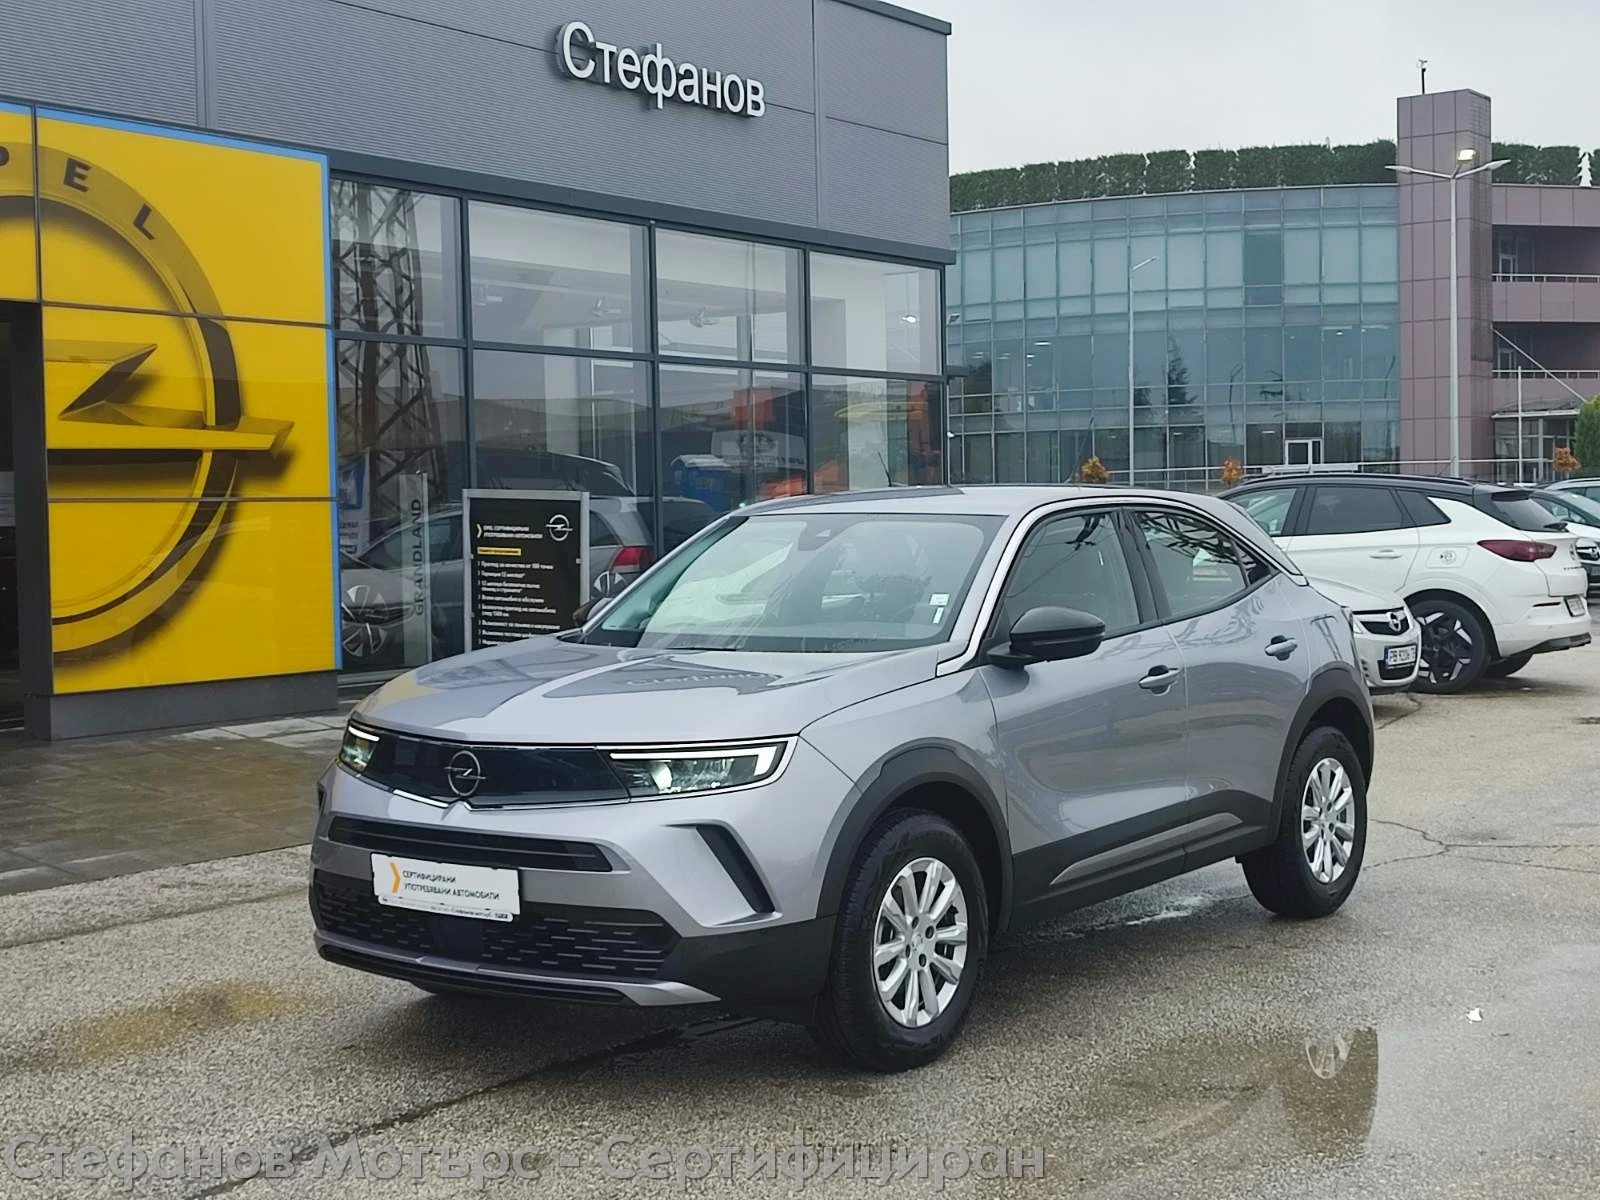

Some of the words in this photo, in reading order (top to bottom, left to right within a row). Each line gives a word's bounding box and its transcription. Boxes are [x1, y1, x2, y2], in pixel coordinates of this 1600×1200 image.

[562, 21, 766, 118] Стефанов
[411, 499, 425, 616] GRANDLAND
[402, 869, 457, 883] СЕРТИФИЦИРАНИ
